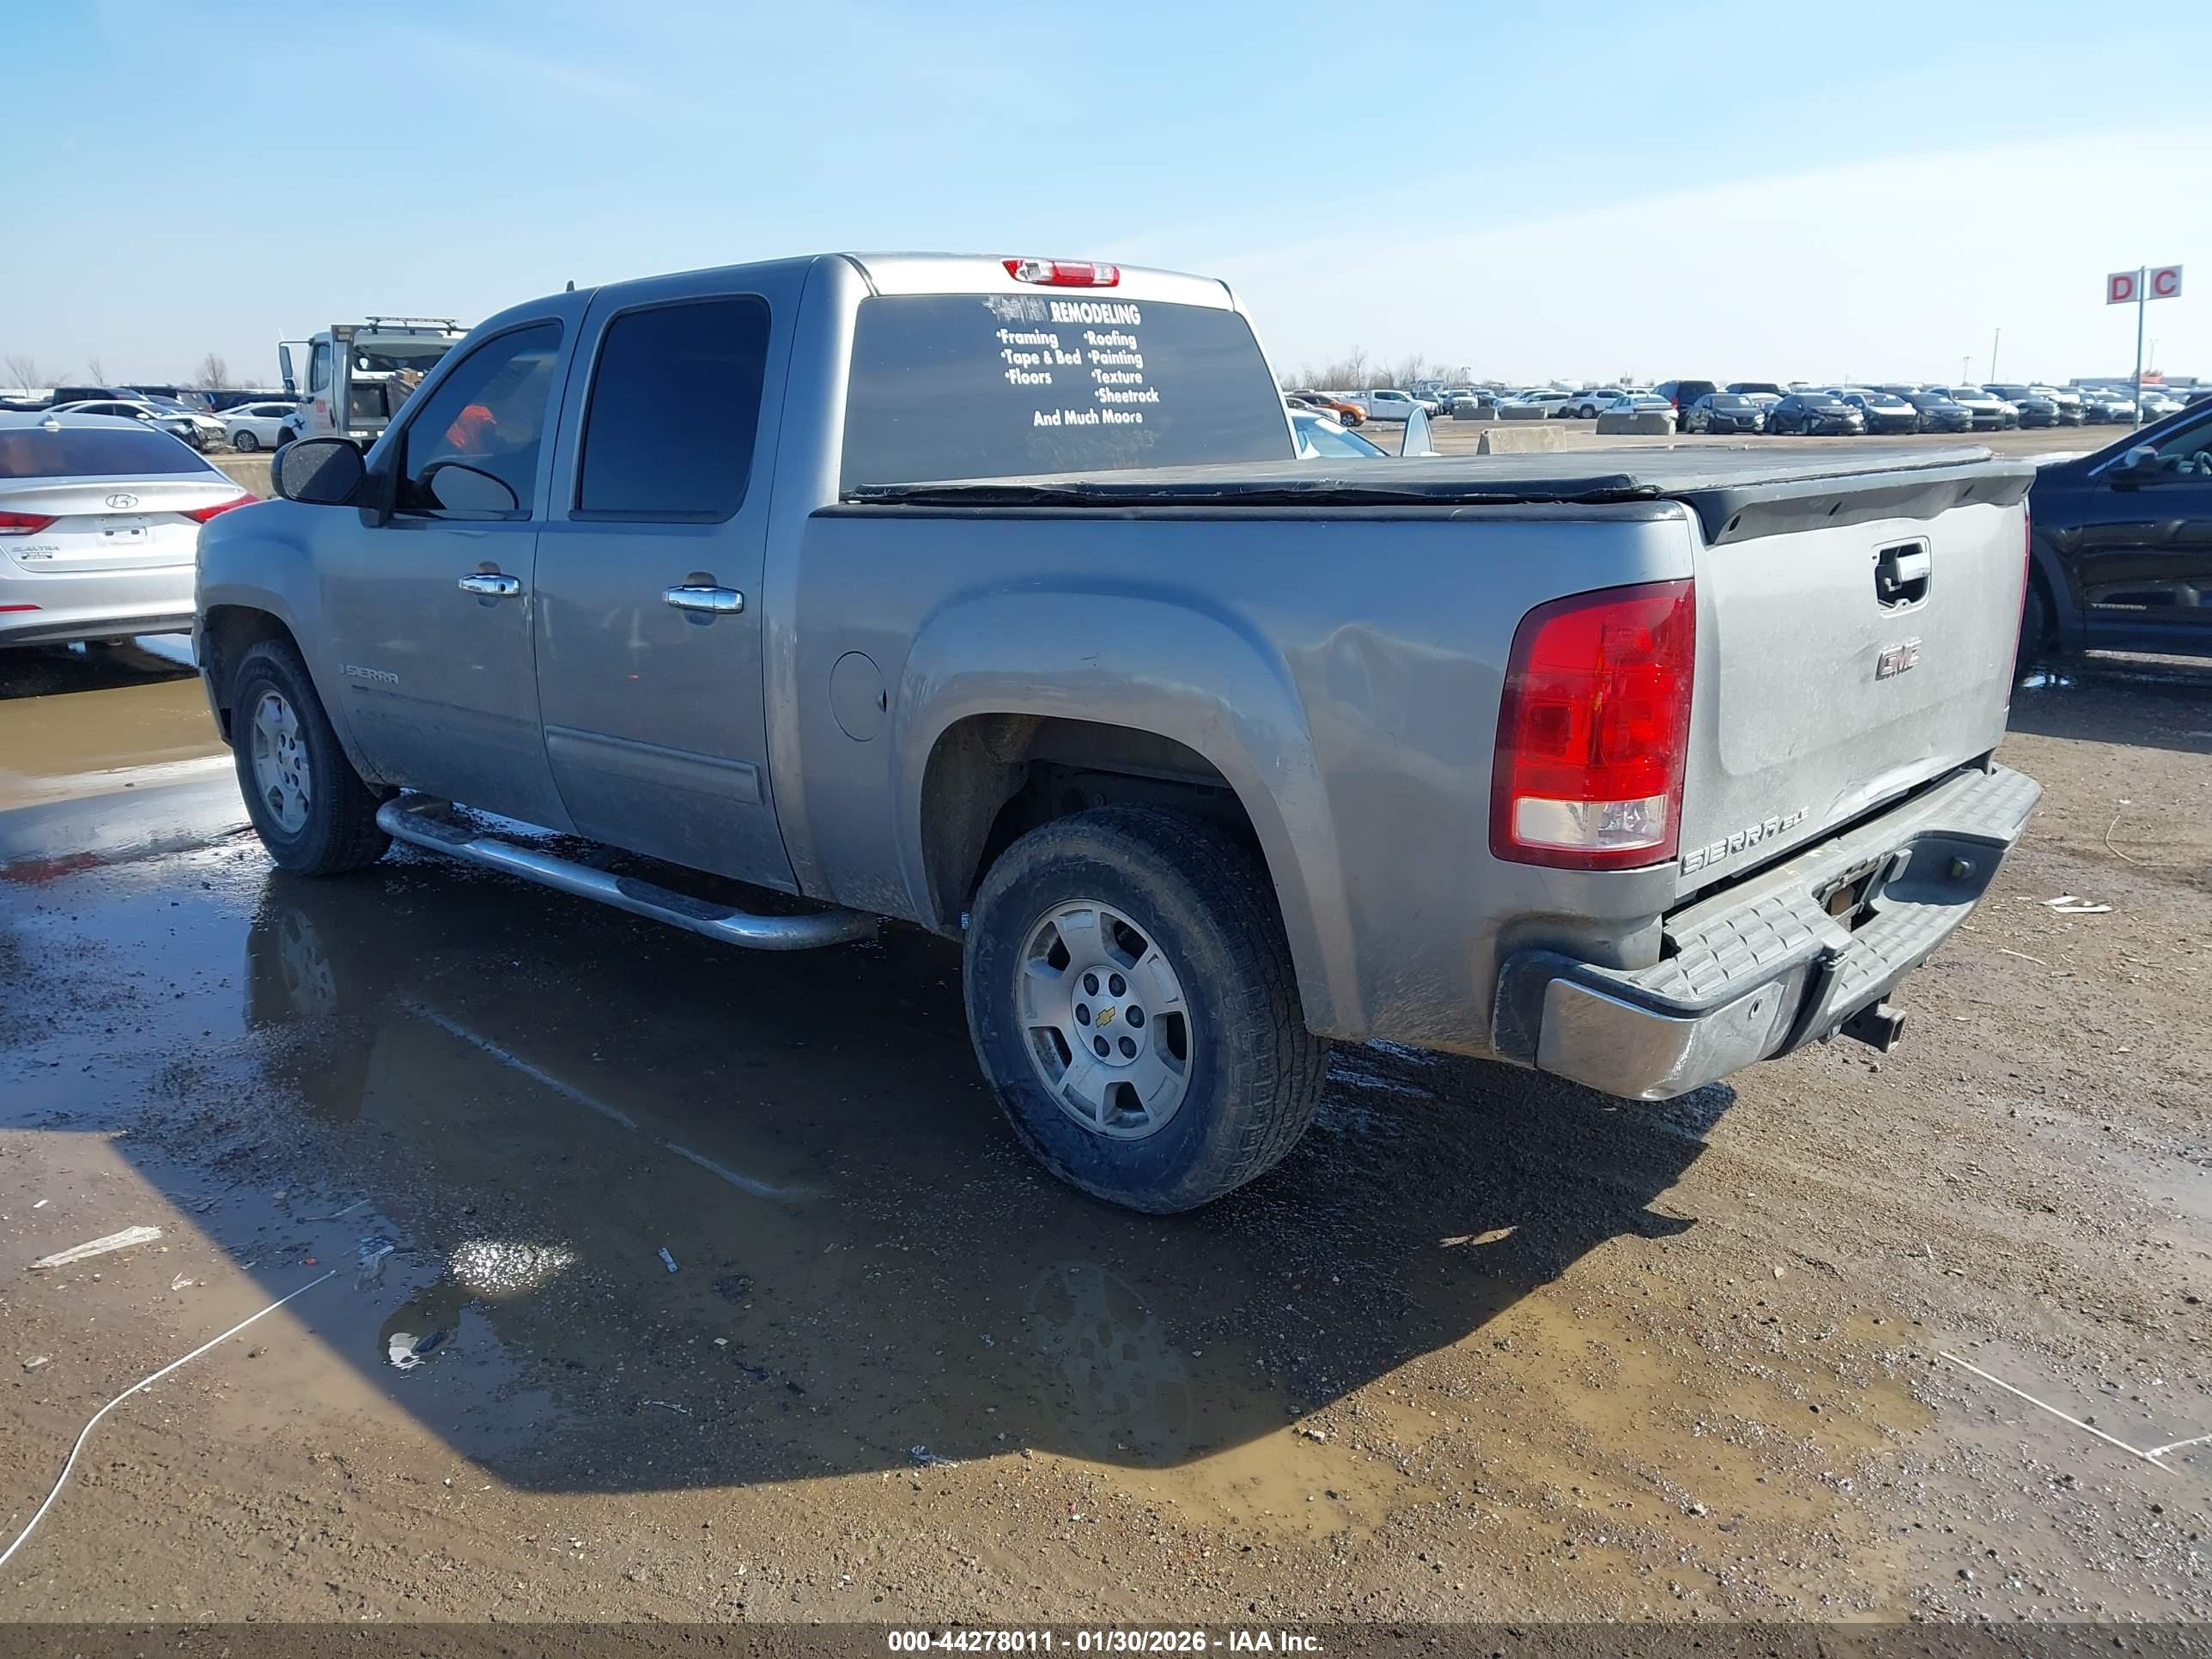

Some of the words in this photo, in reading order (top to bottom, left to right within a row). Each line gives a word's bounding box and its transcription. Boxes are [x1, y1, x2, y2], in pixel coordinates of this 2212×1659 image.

[2112, 276, 2132, 301] D
[2154, 270, 2177, 295] C
[1050, 301, 1141, 325] REMODELING
[1043, 350, 1053, 364] &
[1055, 348, 1082, 365] Bed
[1033, 409, 1061, 427] And
[1064, 408, 1099, 424] Much
[1102, 409, 1143, 424] Moore
[345, 665, 399, 685] SIERRA
[1680, 816, 1780, 878] SIERRA
